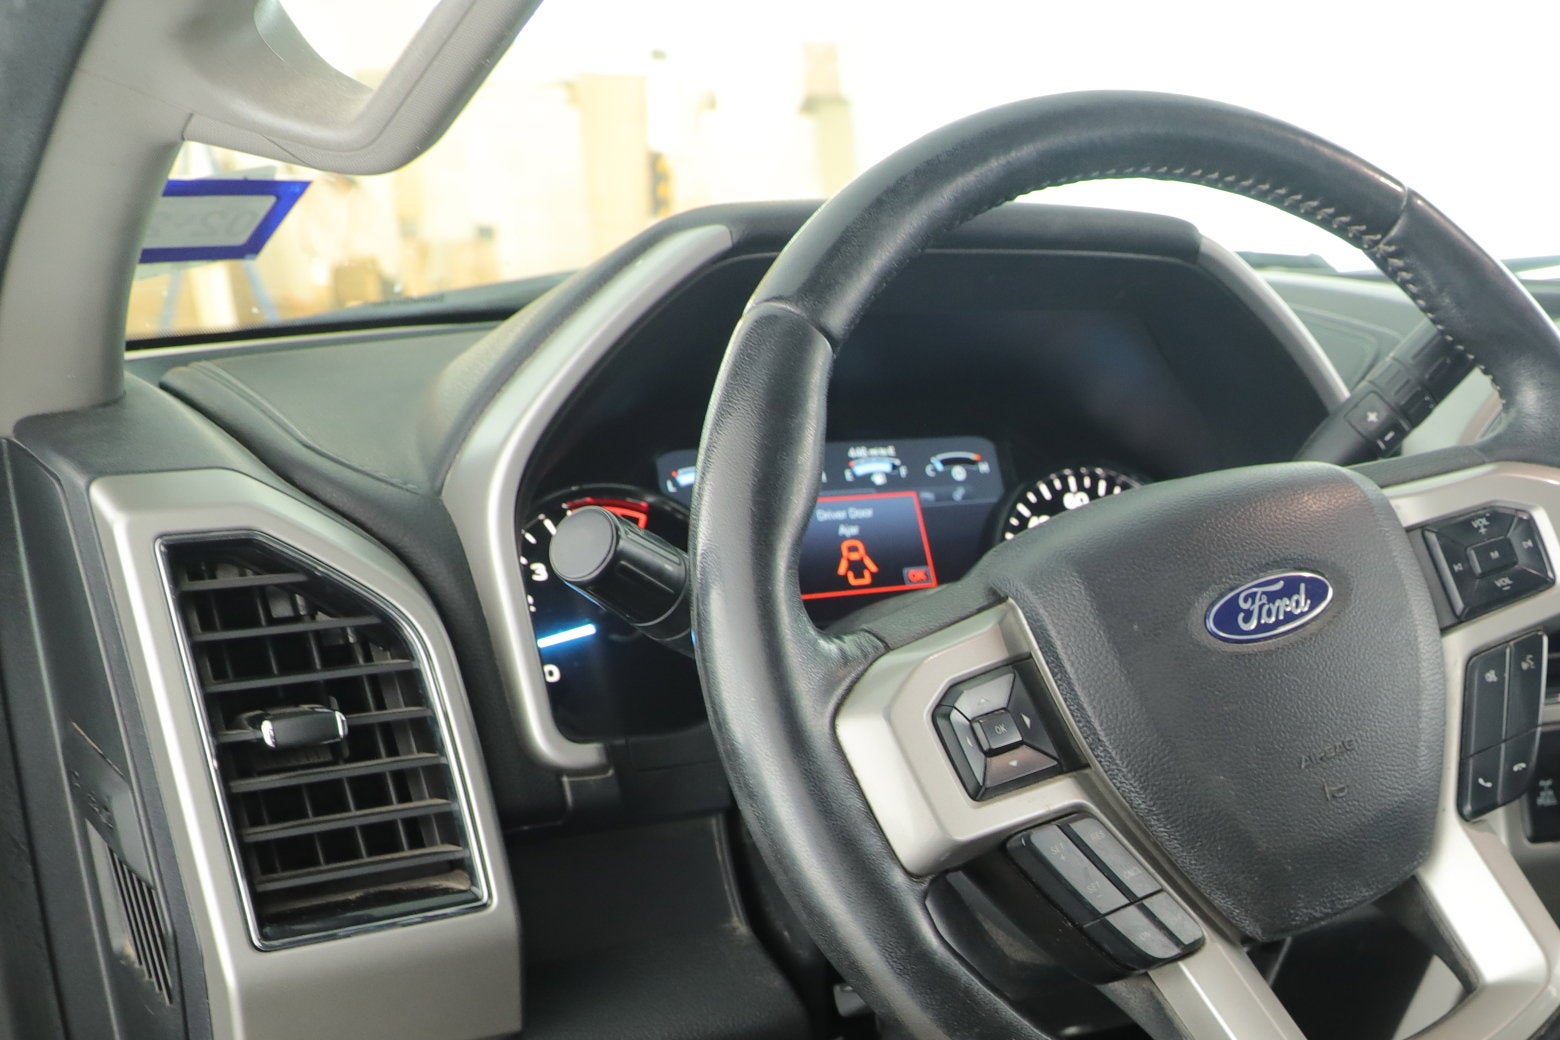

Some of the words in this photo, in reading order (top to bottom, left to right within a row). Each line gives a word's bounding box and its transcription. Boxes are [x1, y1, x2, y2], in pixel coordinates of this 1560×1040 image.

[816, 508, 847, 522] Driver
[848, 507, 874, 520] Door
[838, 524, 860, 537] Ajar
[529, 562, 549, 582] 3
[907, 568, 928, 583] OK
[1237, 580, 1310, 631] Ford
[995, 723, 1008, 735] OK
